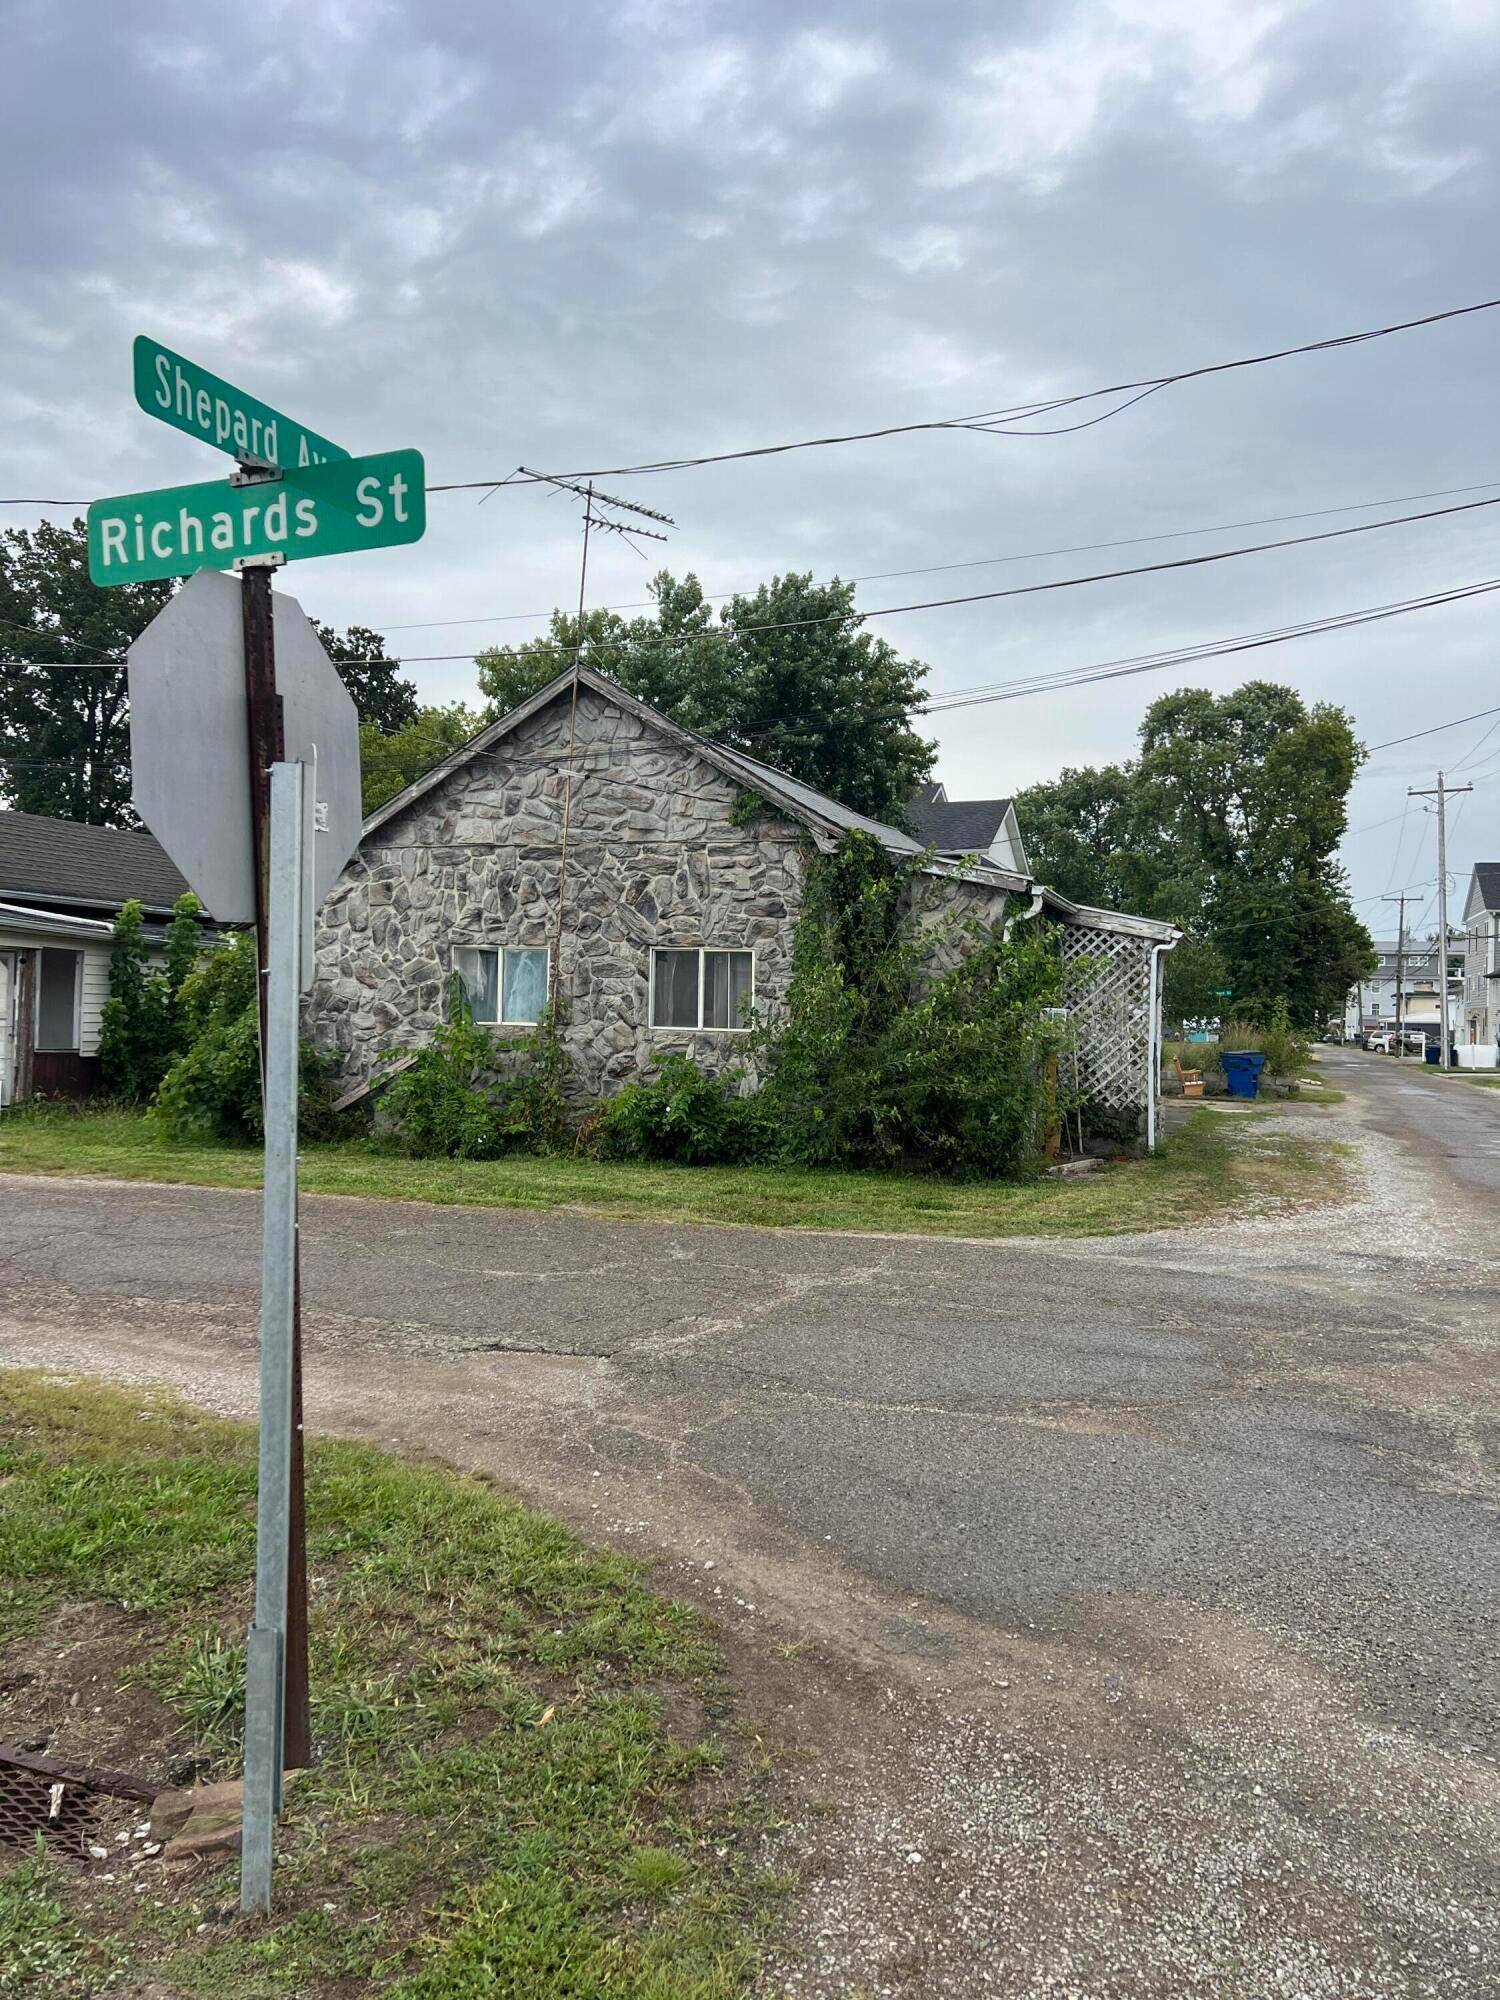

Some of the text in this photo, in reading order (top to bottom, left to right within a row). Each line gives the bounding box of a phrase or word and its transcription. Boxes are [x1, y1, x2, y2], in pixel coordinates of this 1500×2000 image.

[155, 353, 278, 465] Shepard
[101, 473, 408, 566] Richards St
